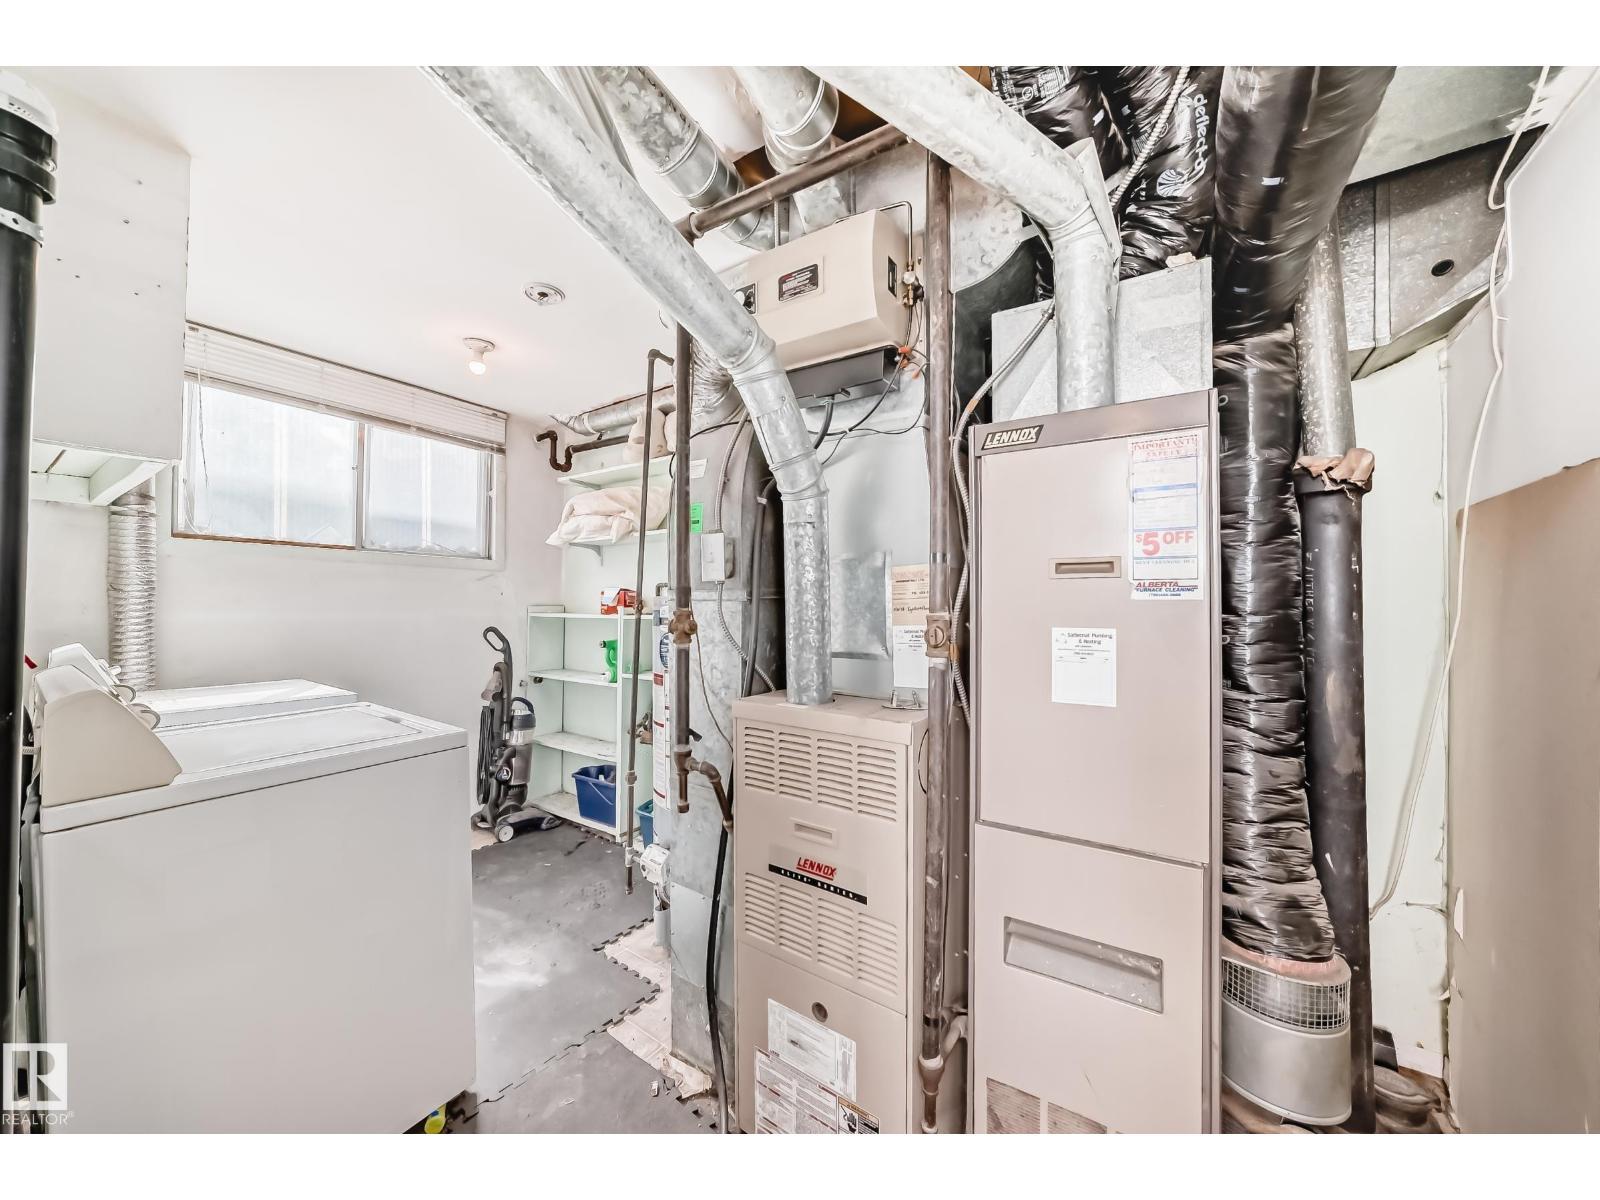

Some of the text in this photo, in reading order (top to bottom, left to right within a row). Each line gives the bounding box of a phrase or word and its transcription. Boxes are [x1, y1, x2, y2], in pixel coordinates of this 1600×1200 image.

[984, 426, 1041, 447] LENNOX
[1162, 530, 1194, 545] OFF
[1135, 580, 1179, 588] ALBERTA
[796, 856, 837, 878] LENNOX
